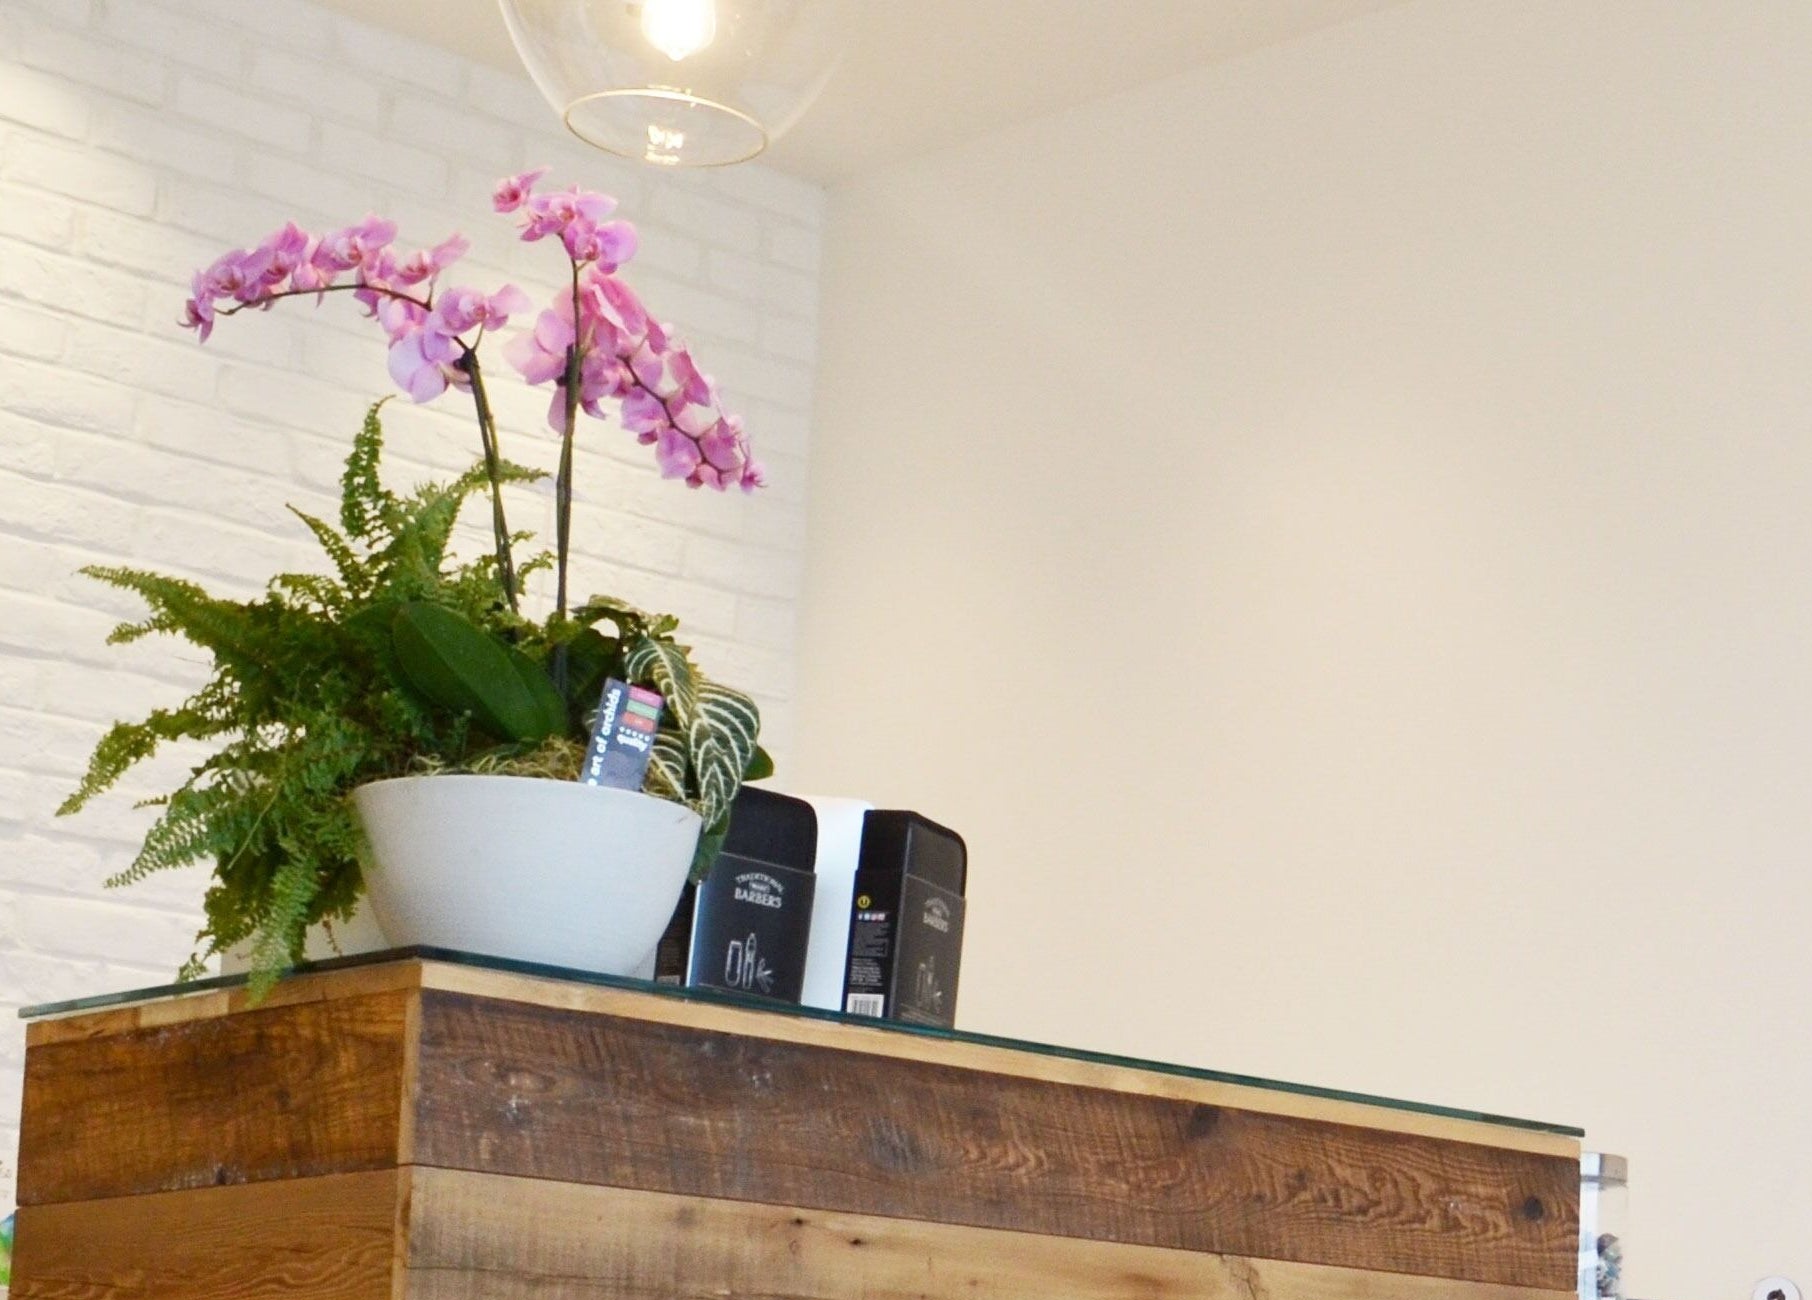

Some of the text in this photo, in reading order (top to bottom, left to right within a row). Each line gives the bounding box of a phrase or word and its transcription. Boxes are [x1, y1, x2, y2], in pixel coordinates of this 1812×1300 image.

[590, 688, 621, 777] art of orchids
[734, 887, 782, 909] BARBERS
